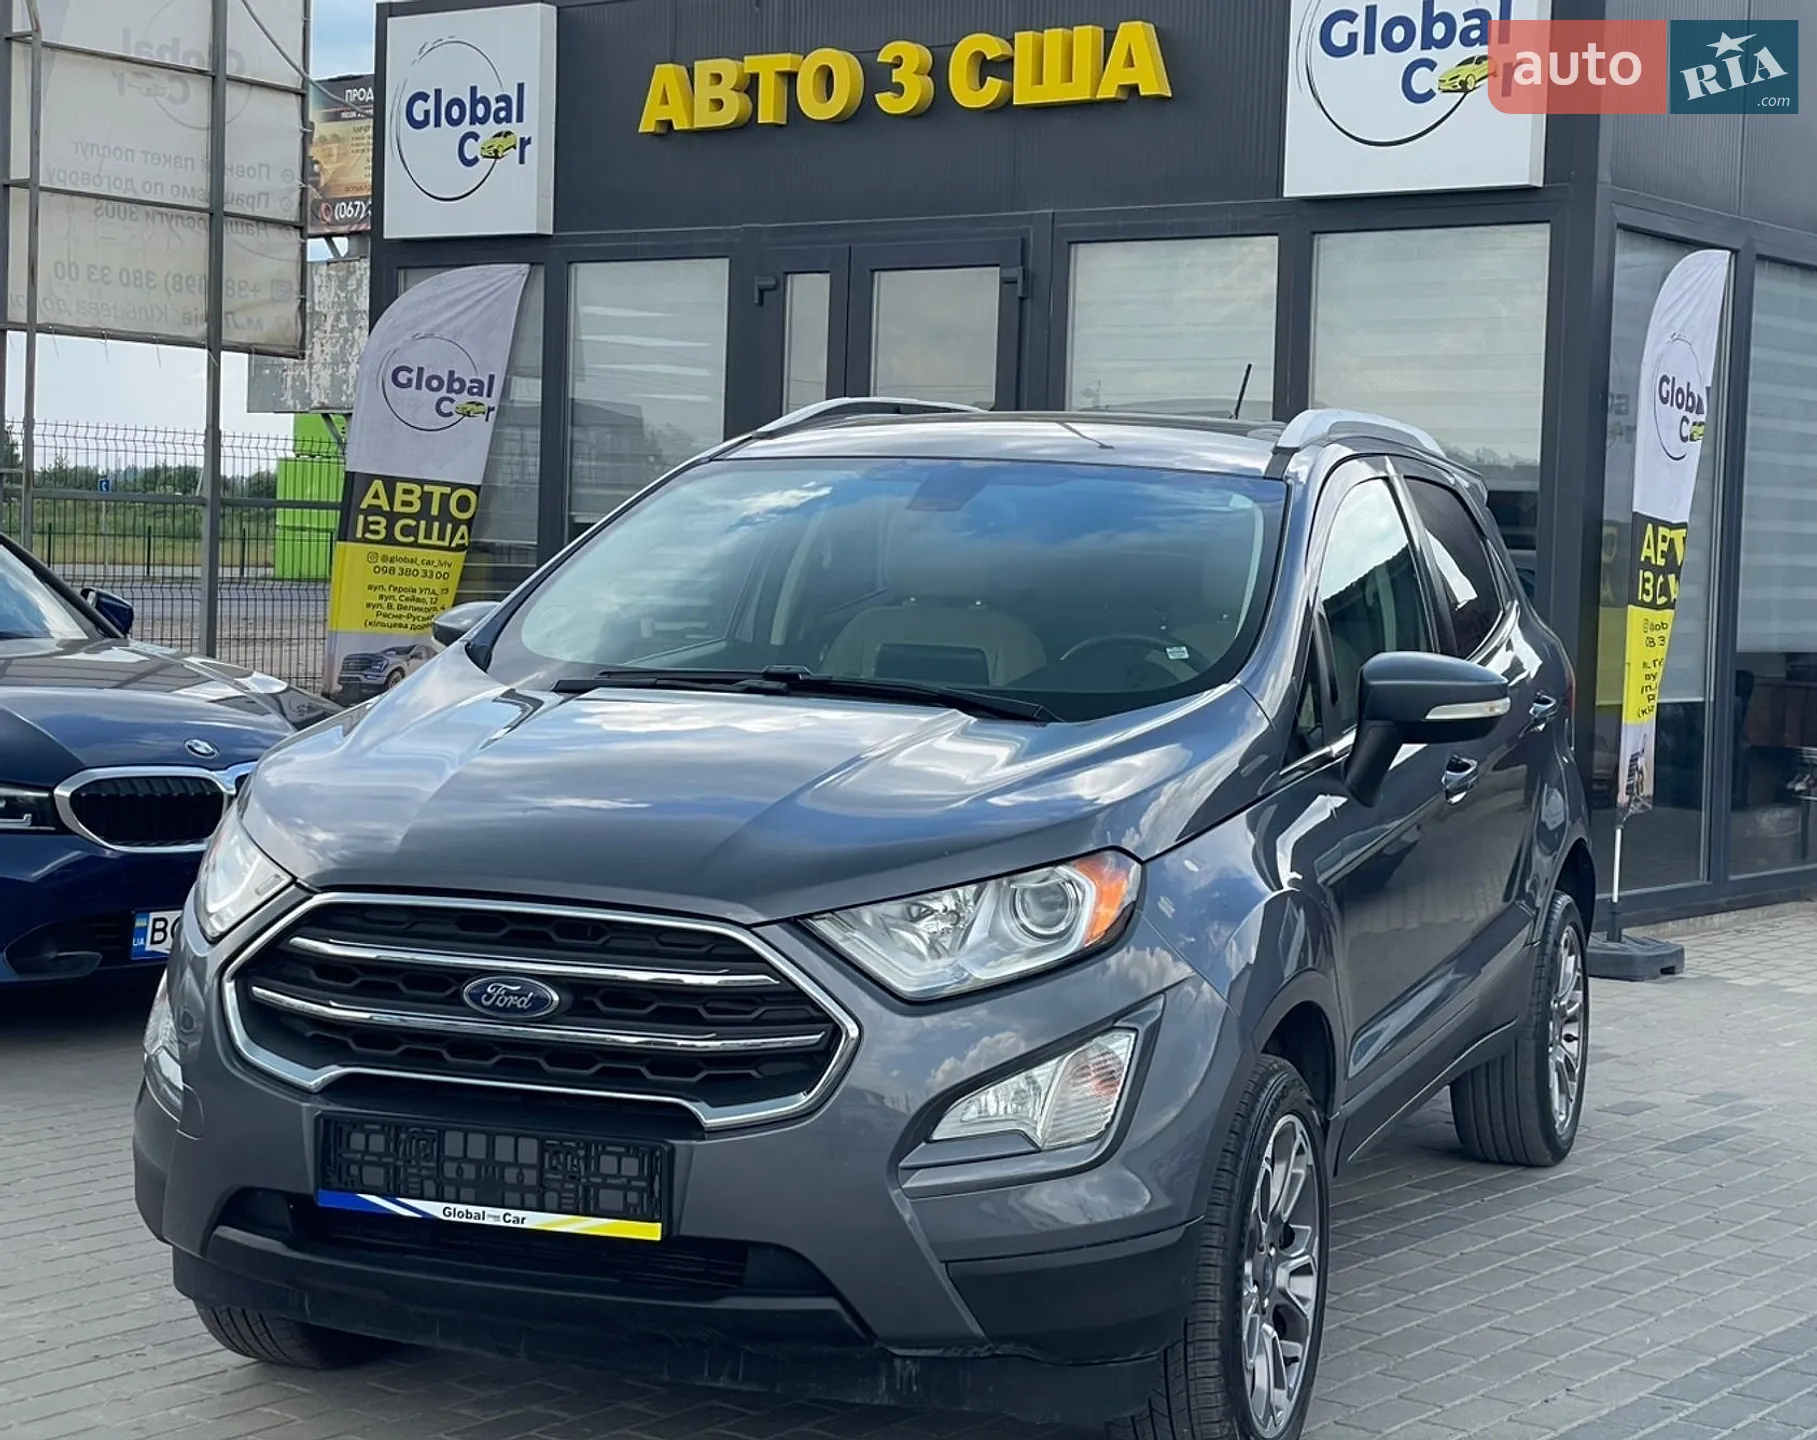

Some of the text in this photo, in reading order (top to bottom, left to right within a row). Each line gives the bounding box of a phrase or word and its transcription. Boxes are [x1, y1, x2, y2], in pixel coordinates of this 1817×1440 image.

[1318, 0, 1512, 59] Global
[638, 46, 865, 135] АВТО
[948, 20, 1173, 111] США
[405, 82, 525, 130] Global
[391, 365, 495, 398] Global
[359, 479, 478, 520] АВТО
[394, 518, 469, 548] США
[373, 565, 395, 576] 098
[398, 566, 420, 578] 380
[481, 982, 534, 1009] Ford
[442, 1206, 527, 1226] Global Car
